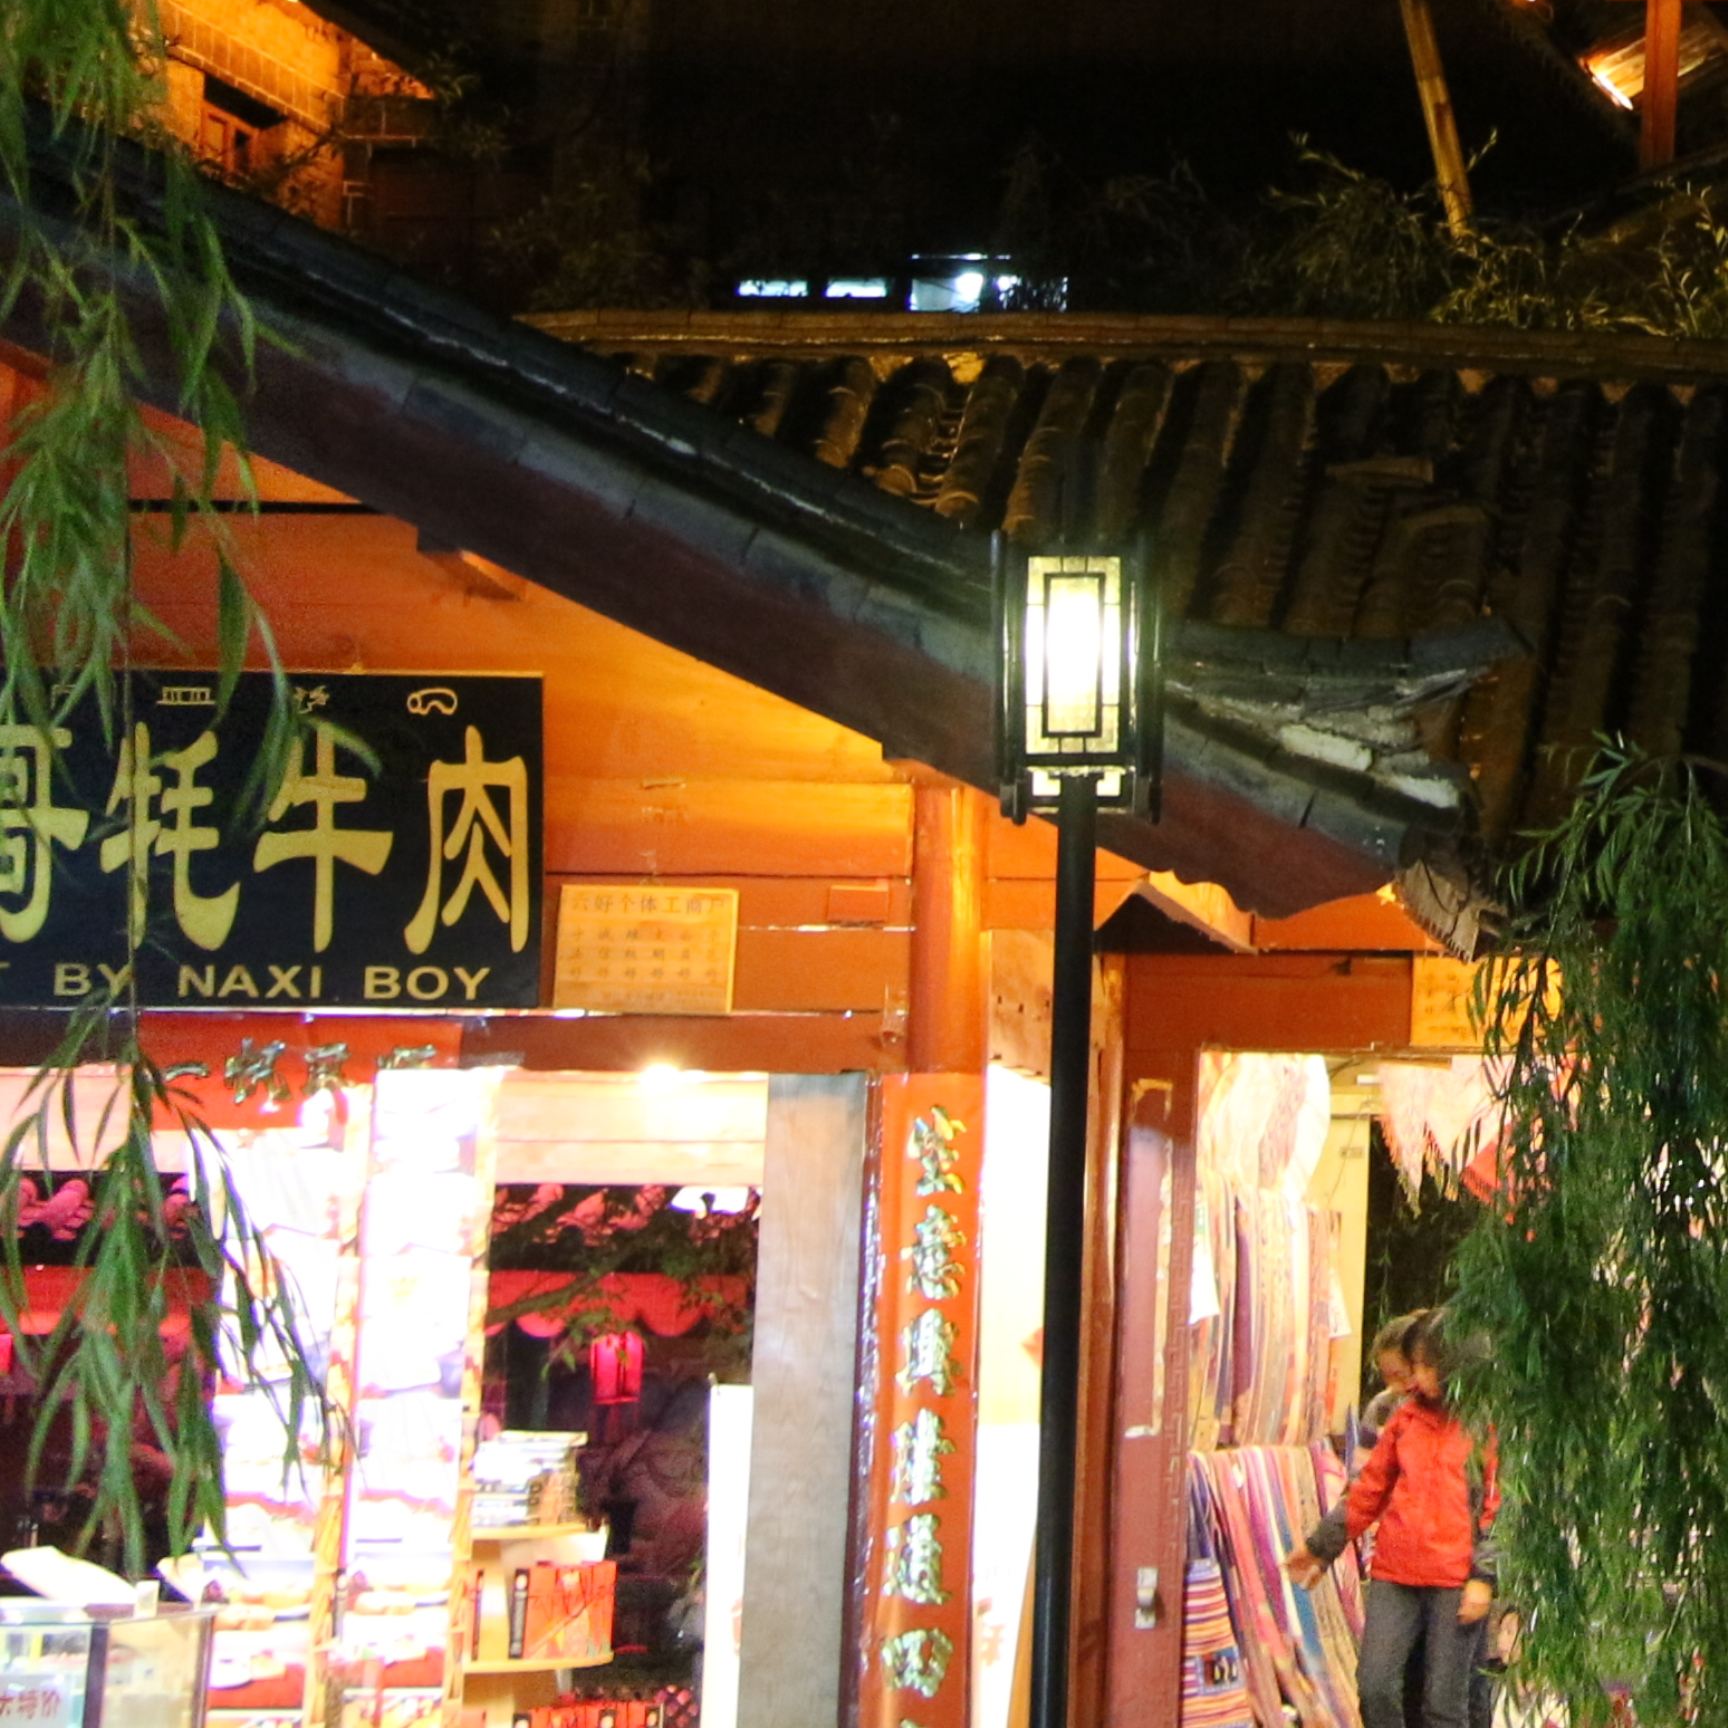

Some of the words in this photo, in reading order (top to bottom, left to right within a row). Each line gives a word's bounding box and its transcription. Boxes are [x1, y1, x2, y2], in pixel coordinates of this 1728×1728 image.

[53, 962, 132, 997] BY
[177, 964, 324, 999] NAXI
[363, 966, 490, 1000] BOY
